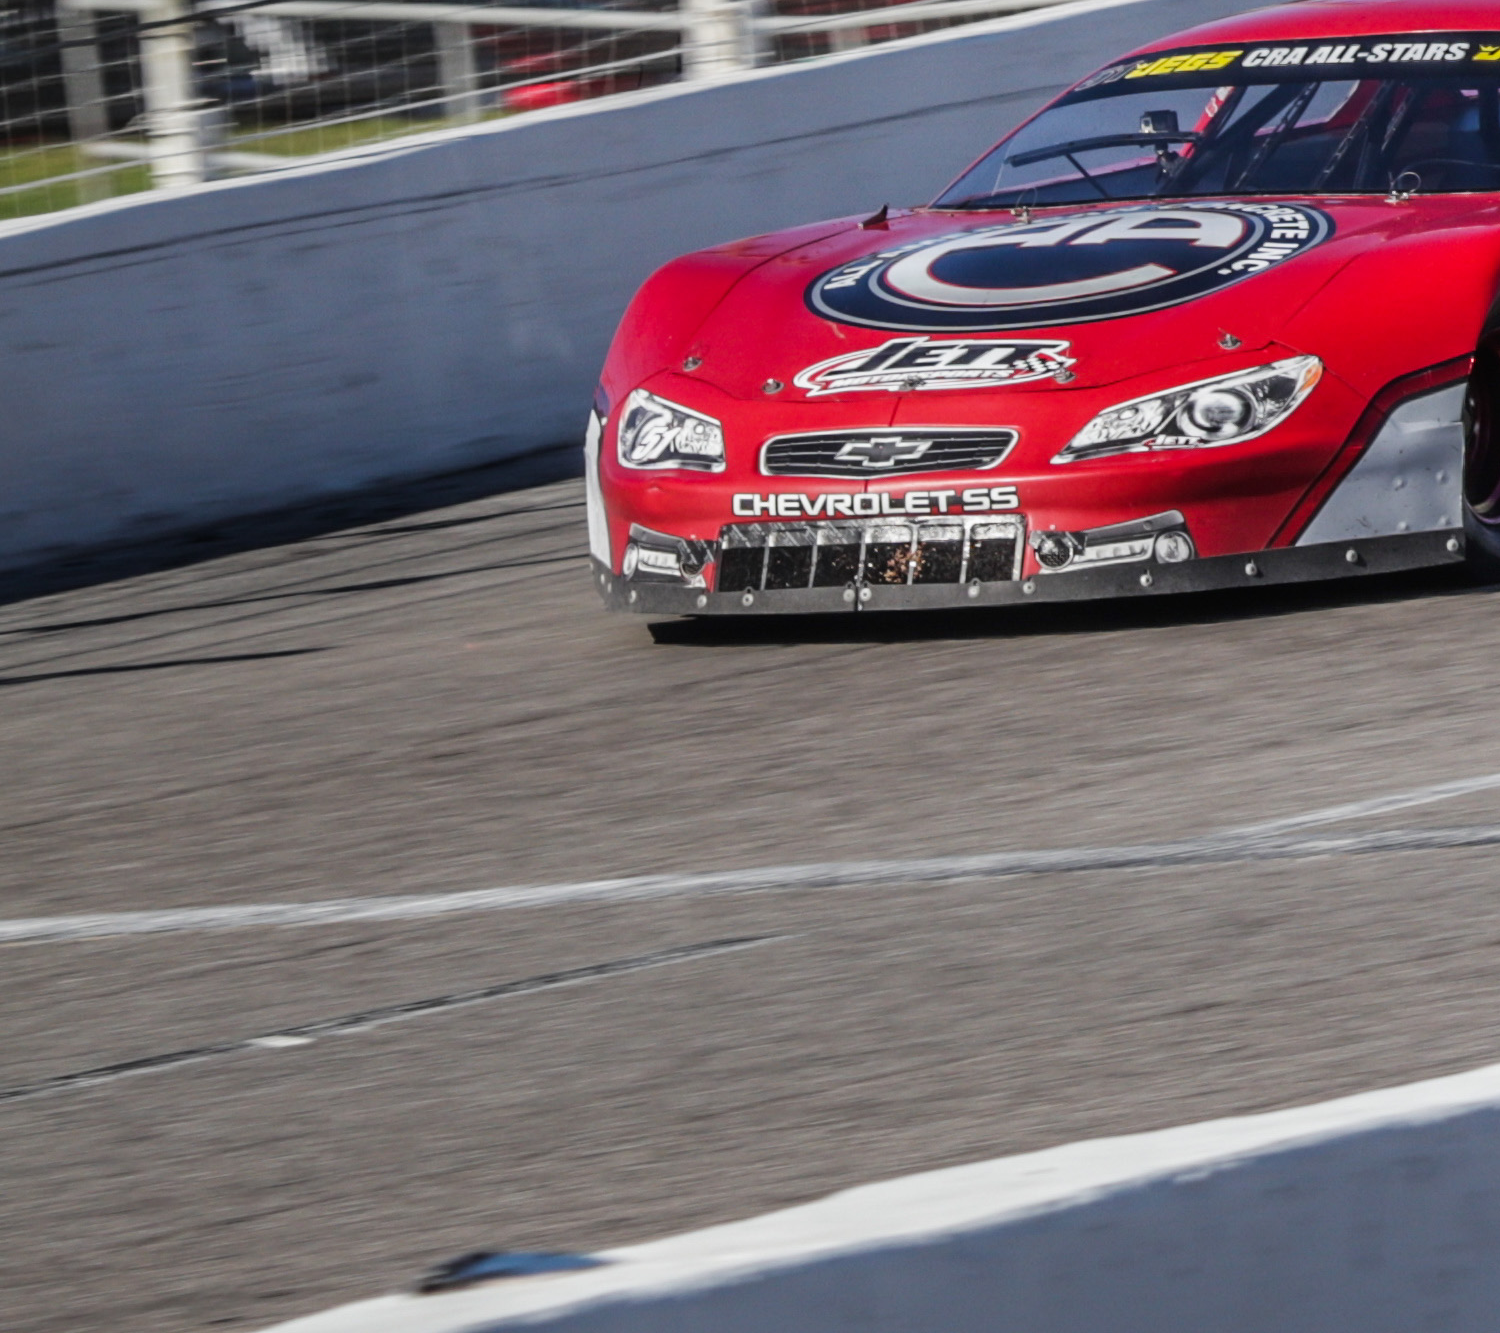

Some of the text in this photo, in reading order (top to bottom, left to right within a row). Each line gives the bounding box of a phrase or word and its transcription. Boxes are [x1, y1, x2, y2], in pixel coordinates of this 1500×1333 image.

[1125, 50, 1244, 79] JEGS
[1242, 47, 1304, 68] CRA
[1304, 42, 1471, 65] ALL-STARS
[1217, 241, 1300, 275] INC.
[733, 486, 1019, 517] CHEVROLET SS
